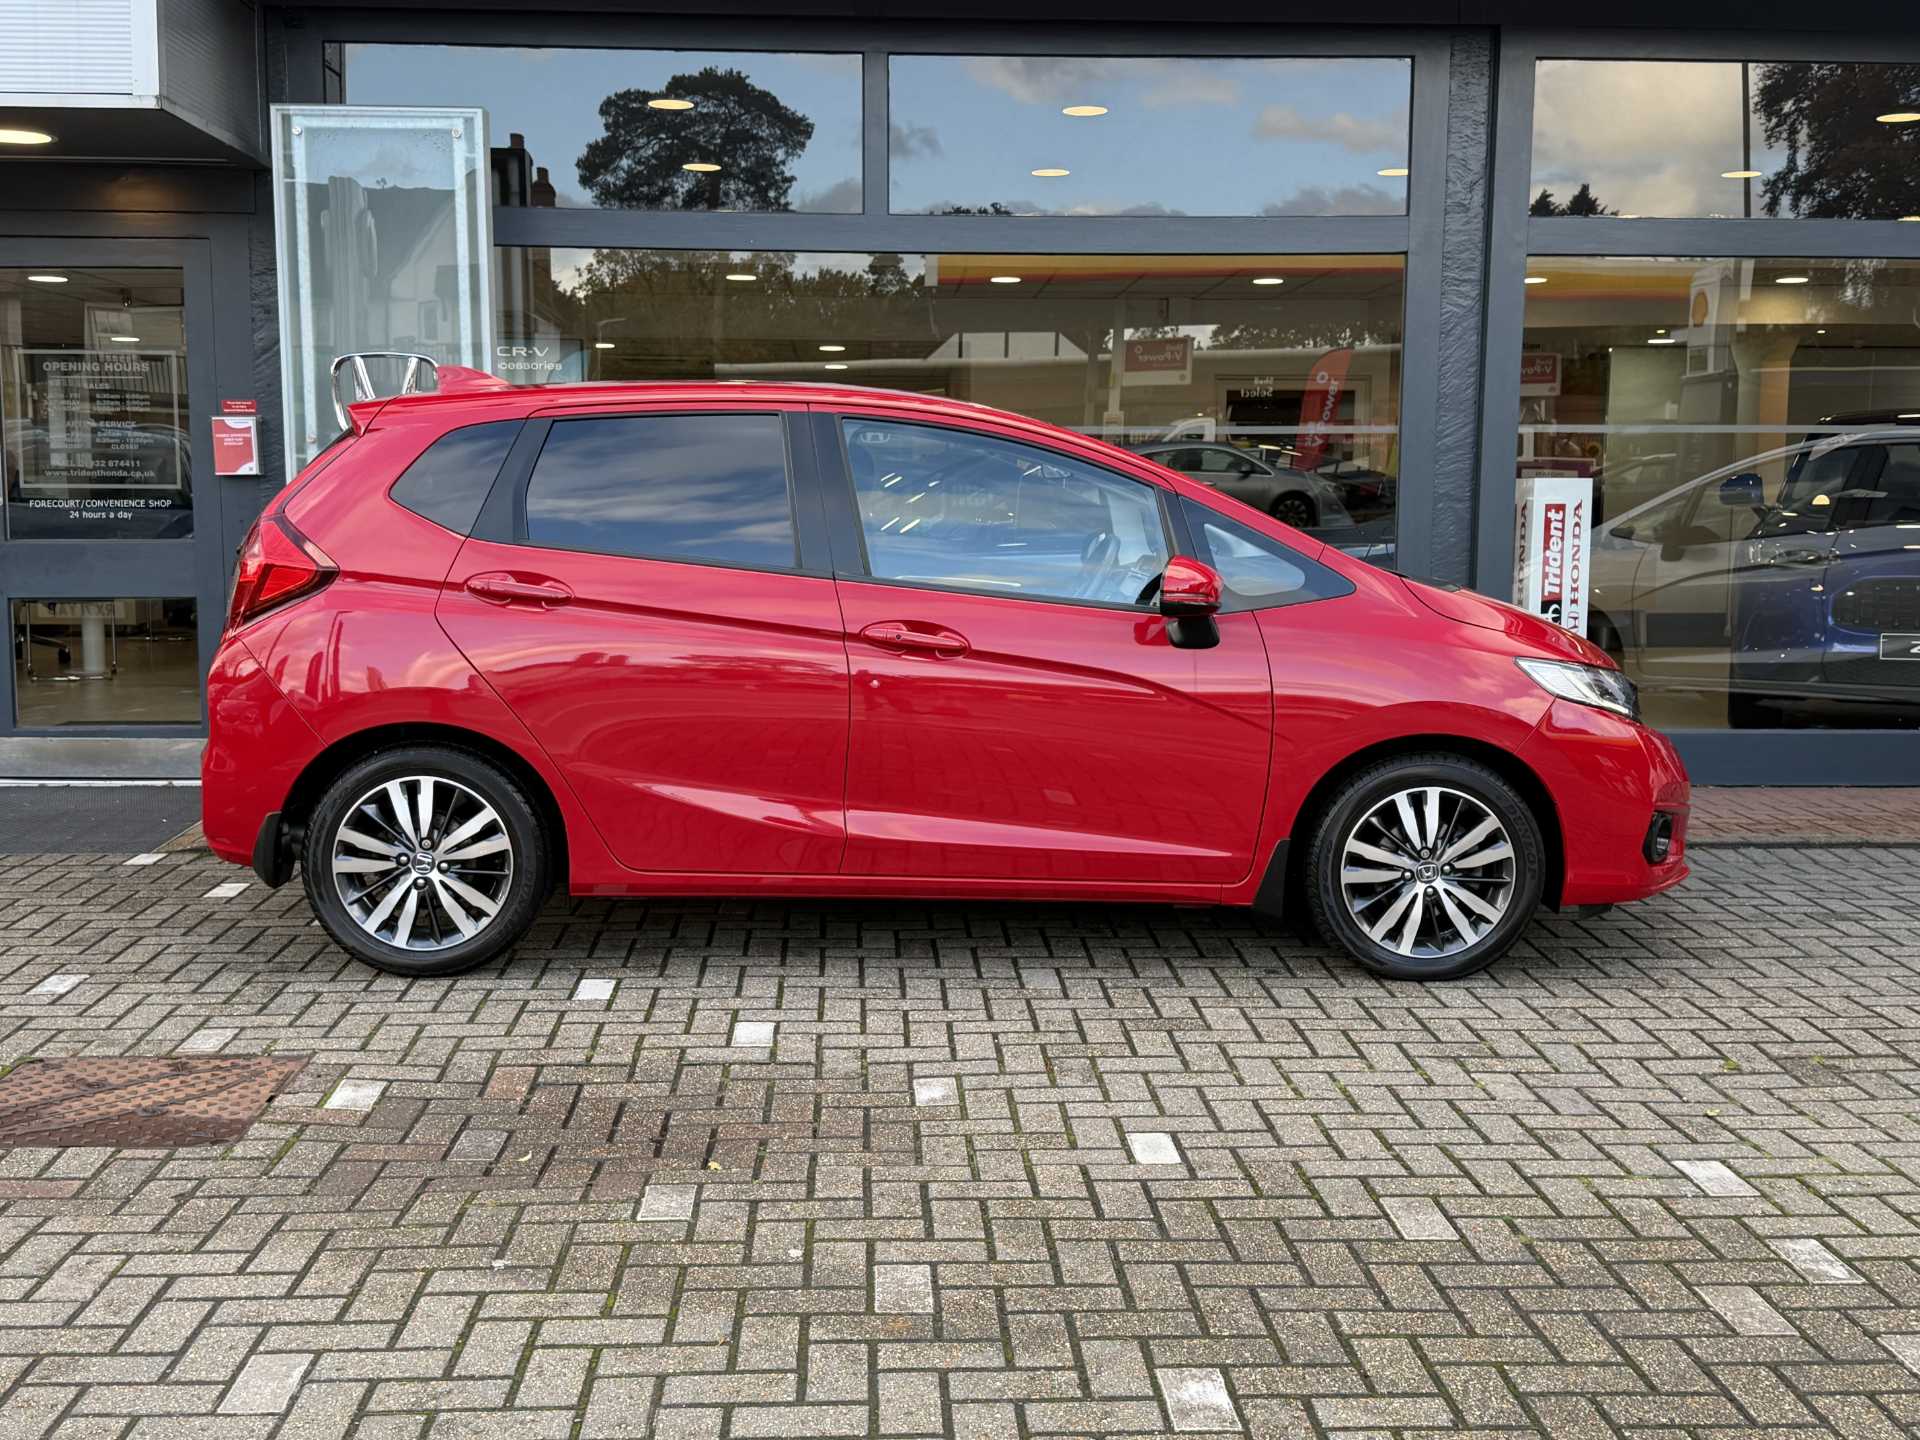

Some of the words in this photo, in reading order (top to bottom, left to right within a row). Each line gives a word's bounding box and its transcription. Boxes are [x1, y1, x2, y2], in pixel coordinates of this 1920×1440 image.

[496, 345, 549, 357] CR-V
[42, 361, 100, 372] OPENING
[104, 361, 151, 372] HOURS
[29, 499, 146, 508] FORECOURT/CONVENIENCE
[148, 499, 172, 508] SHOP
[69, 510, 80, 519] 24
[82, 510, 107, 519] hours
[109, 511, 115, 519] a
[117, 510, 133, 520] day
[1543, 508, 1564, 597] Trident
[1570, 498, 1583, 608] HONDA
